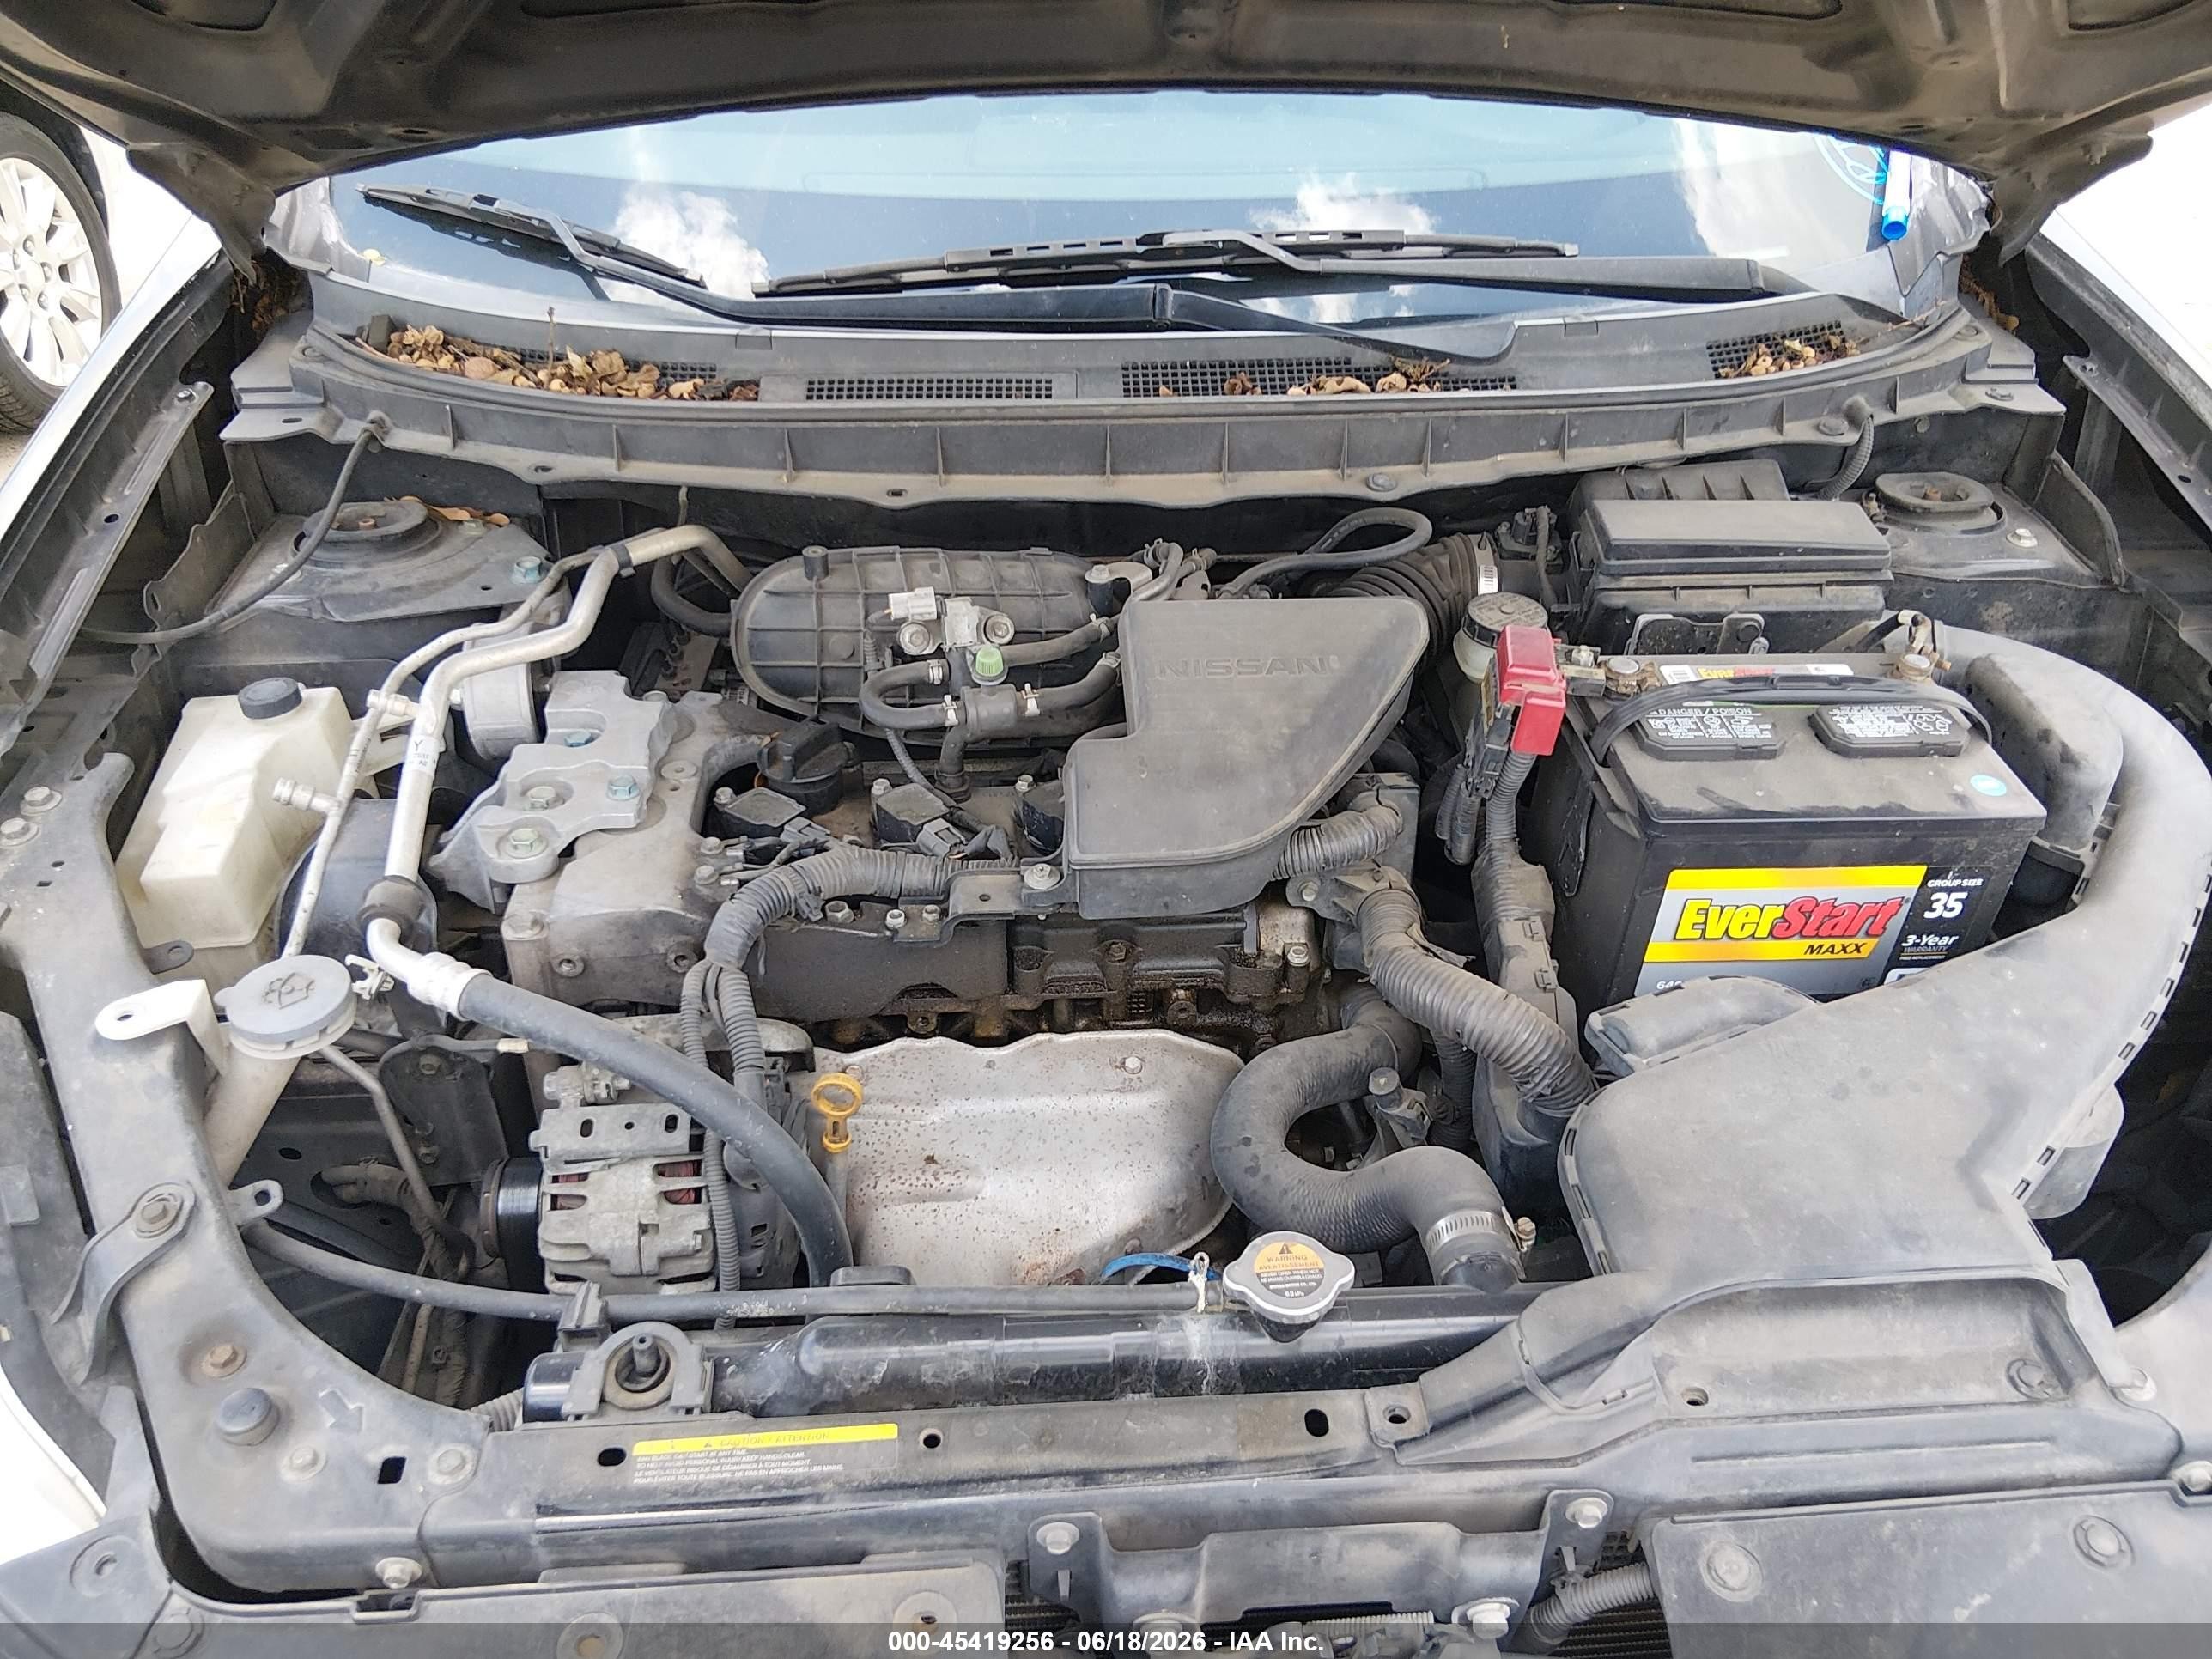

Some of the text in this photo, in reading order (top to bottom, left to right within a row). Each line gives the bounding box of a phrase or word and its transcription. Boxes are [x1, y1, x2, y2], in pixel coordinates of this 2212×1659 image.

[1156, 657, 1329, 680] NISSAN
[1923, 891, 1968, 919] 35
[1673, 896, 1905, 941] EverStart
[1803, 942, 1868, 956] MAXX
[1901, 934, 1959, 946] 3-Year
[720, 1437, 763, 1446] CAUTION
[775, 1431, 830, 1443] ATTENTION
